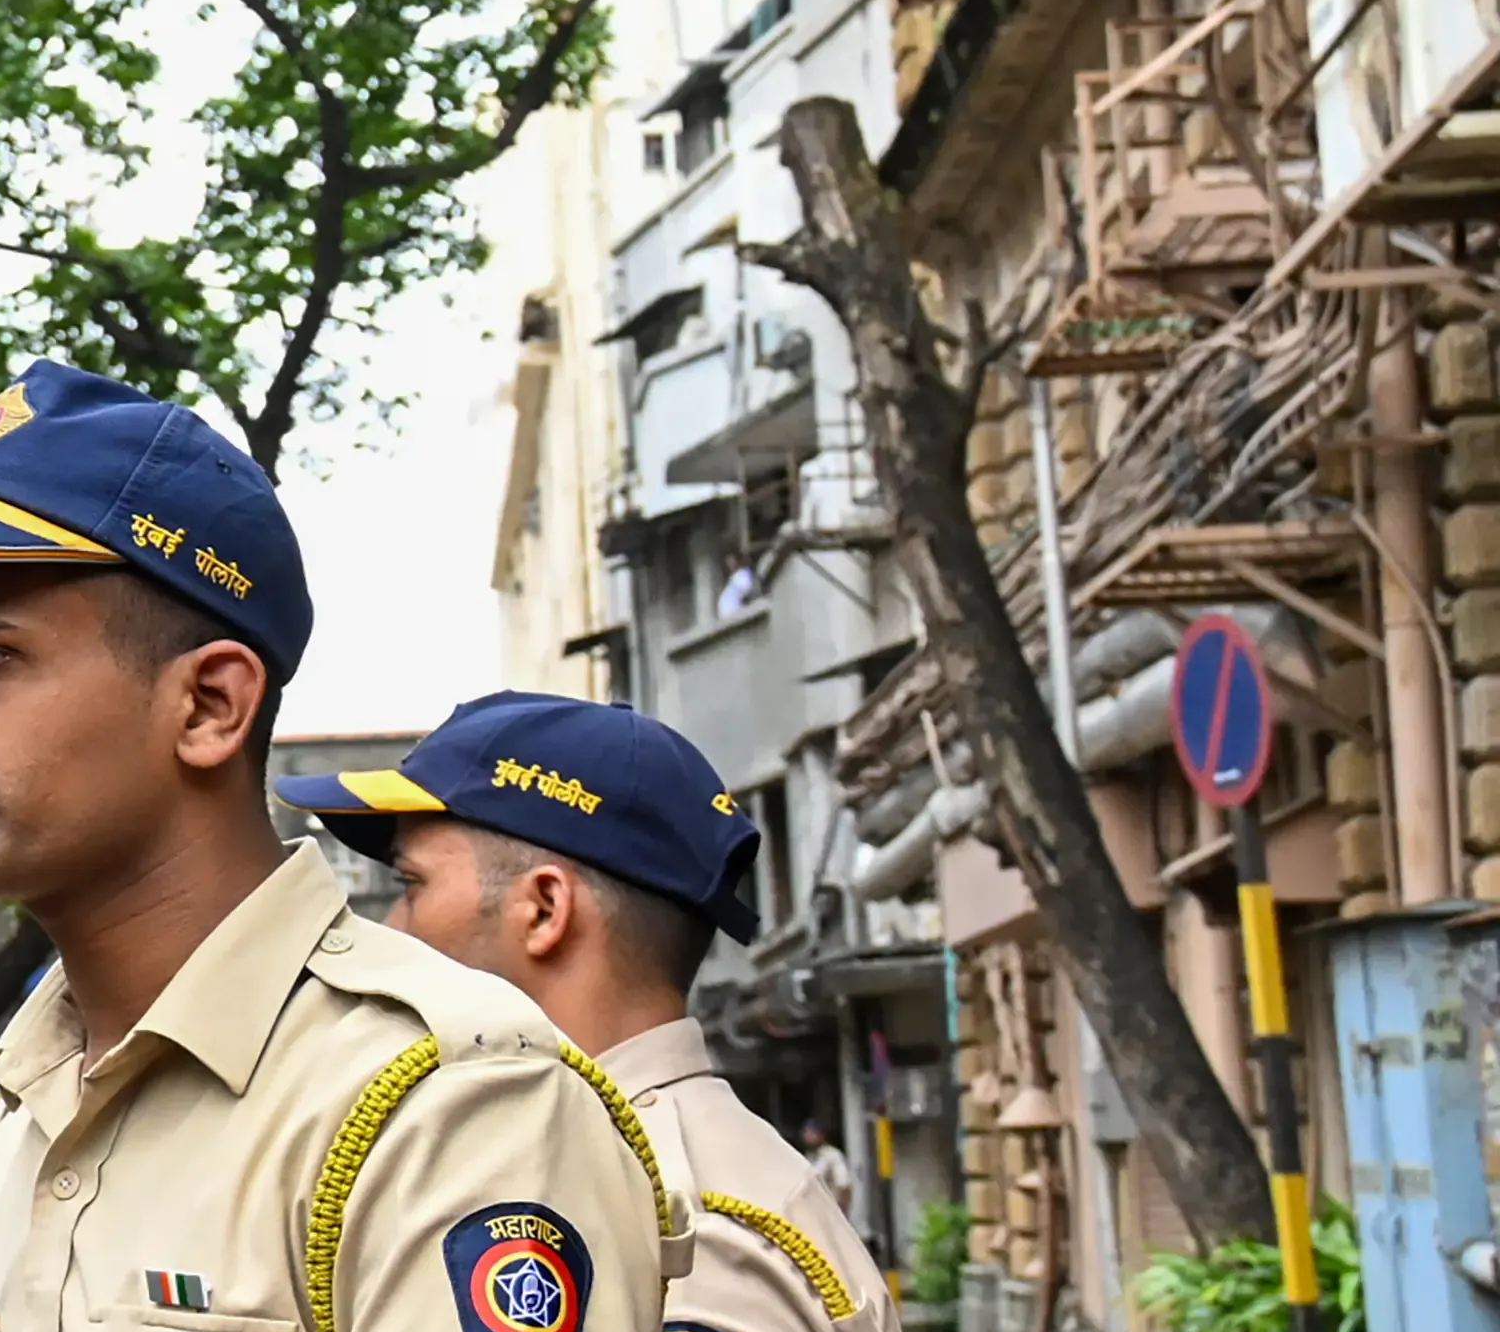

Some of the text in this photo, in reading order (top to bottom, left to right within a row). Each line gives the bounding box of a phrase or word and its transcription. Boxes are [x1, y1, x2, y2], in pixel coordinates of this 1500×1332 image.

[131, 513, 253, 600] मुंबई पोलीस
[491, 757, 603, 815] मुंबई पोलीस
